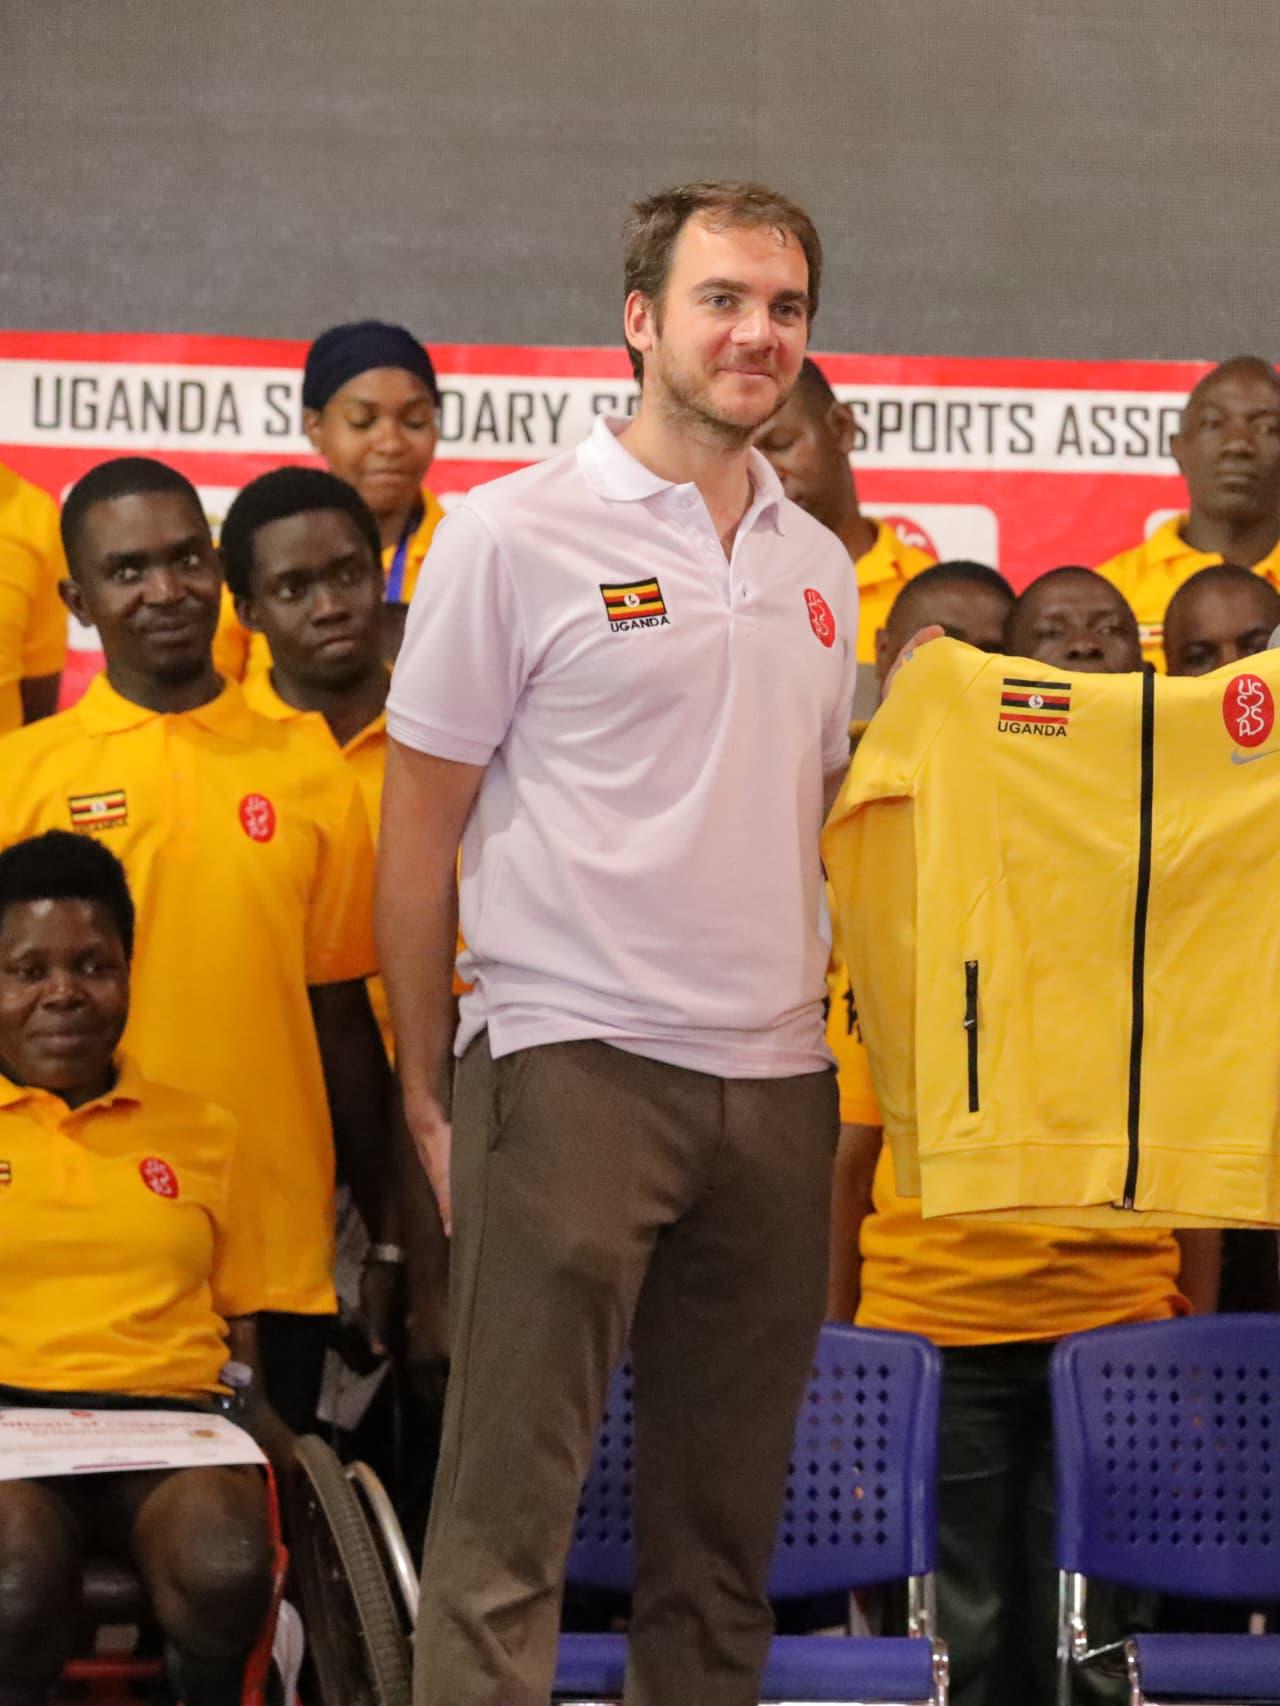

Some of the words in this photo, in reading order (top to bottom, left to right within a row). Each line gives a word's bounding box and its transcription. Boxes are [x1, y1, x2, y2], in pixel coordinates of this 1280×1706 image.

[33, 376, 241, 435] UGANDA
[264, 384, 571, 444] SDARY
[848, 400, 1036, 457] SPORTS
[610, 615, 671, 633] UGANDA
[997, 720, 1067, 737] UGANDA
